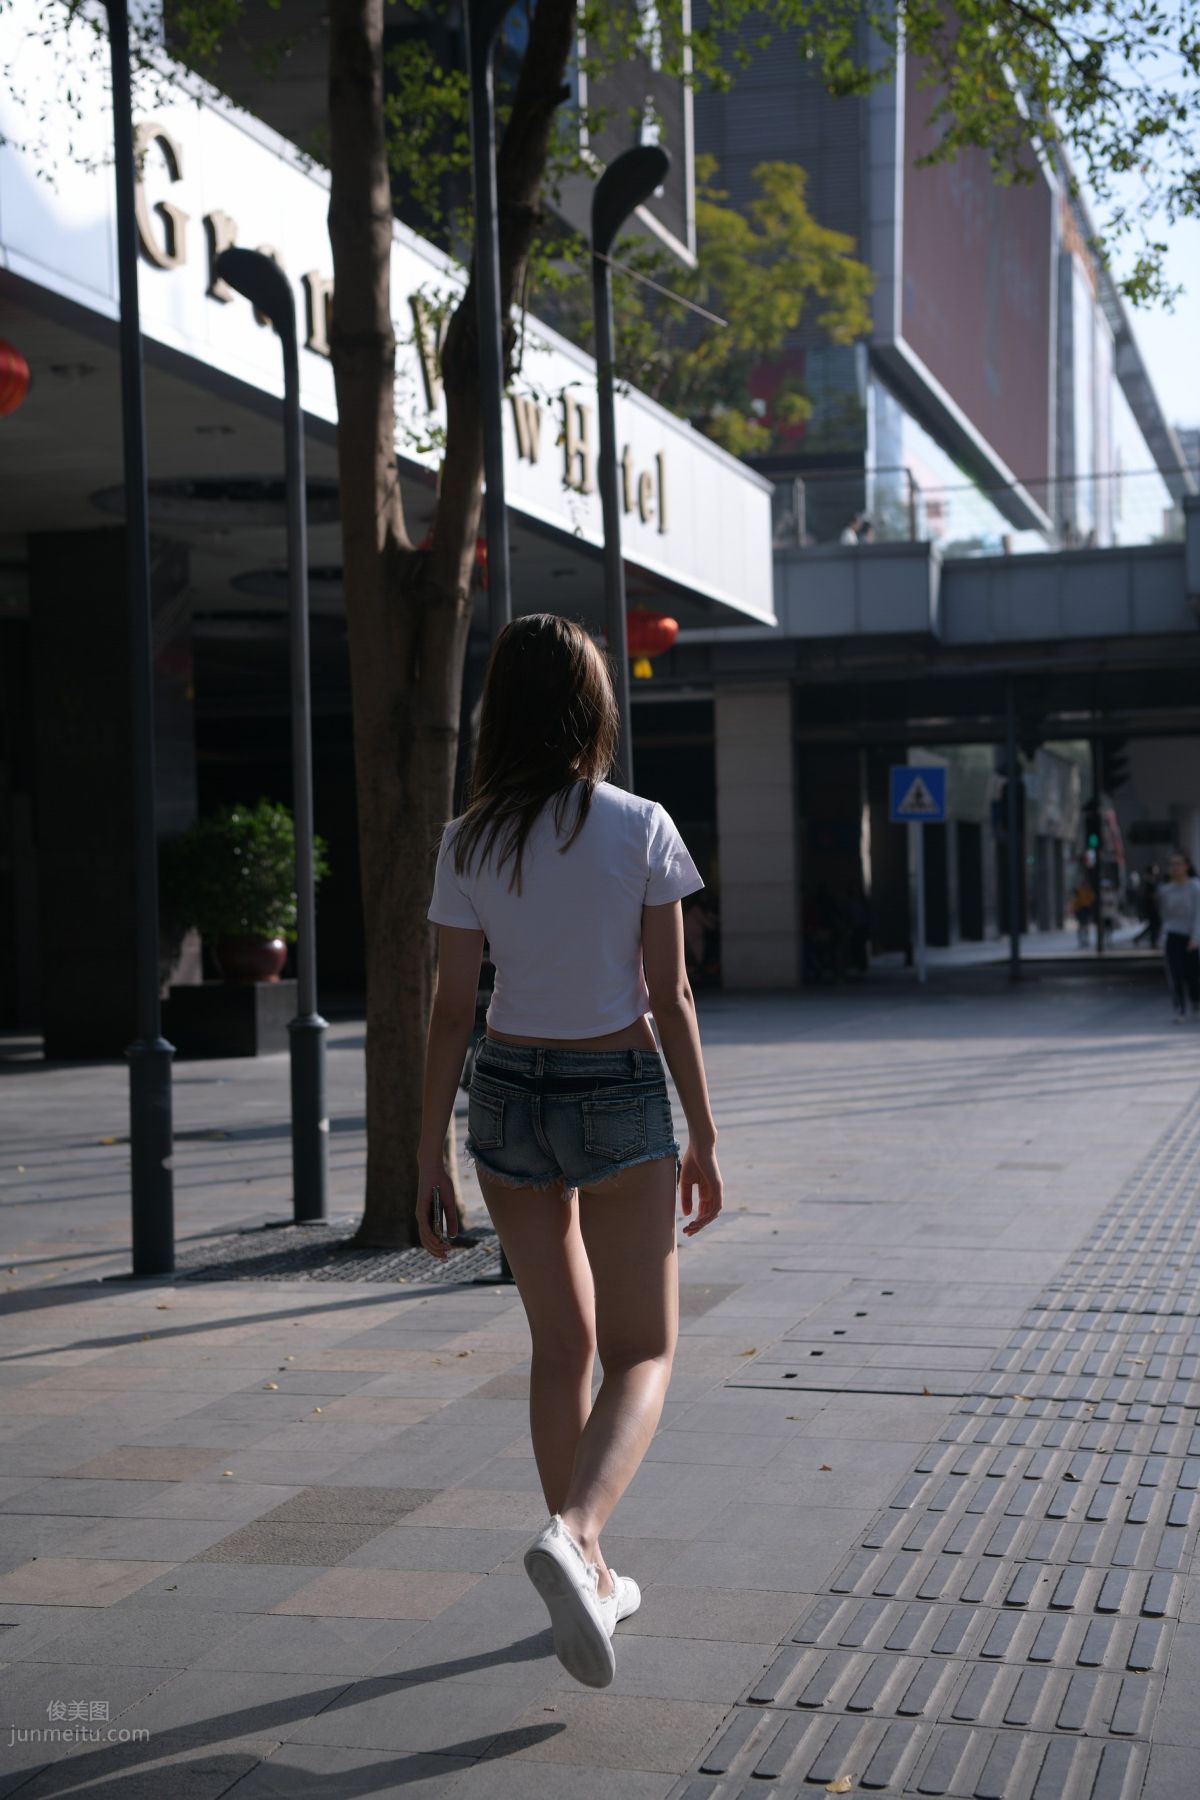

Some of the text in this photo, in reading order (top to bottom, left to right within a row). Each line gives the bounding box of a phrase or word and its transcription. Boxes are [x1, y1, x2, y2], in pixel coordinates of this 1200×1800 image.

[134, 121, 668, 535] Grn Vw Htel
